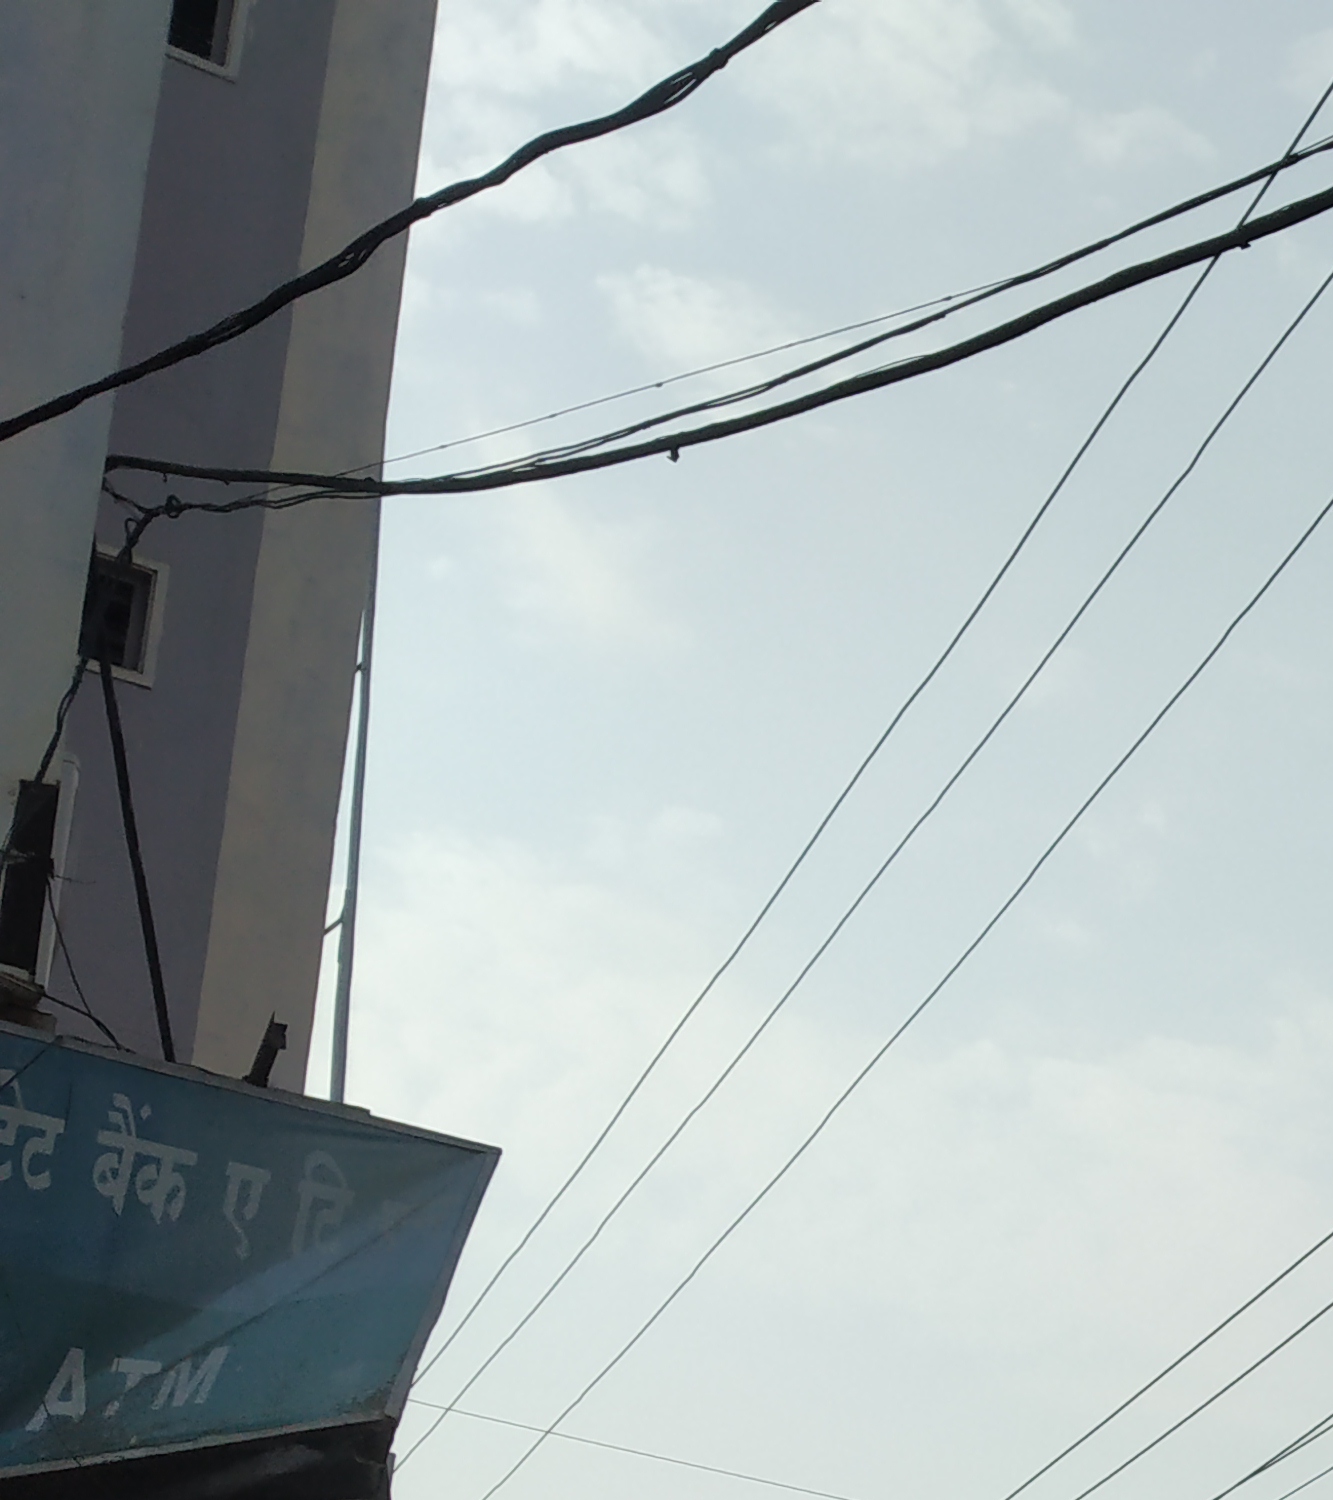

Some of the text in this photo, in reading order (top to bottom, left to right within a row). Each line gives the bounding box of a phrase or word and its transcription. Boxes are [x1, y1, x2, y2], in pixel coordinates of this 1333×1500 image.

[93, 1092, 198, 1224] बैंक
[223, 1161, 271, 1260] ए
[26, 1347, 229, 1431] ATM
